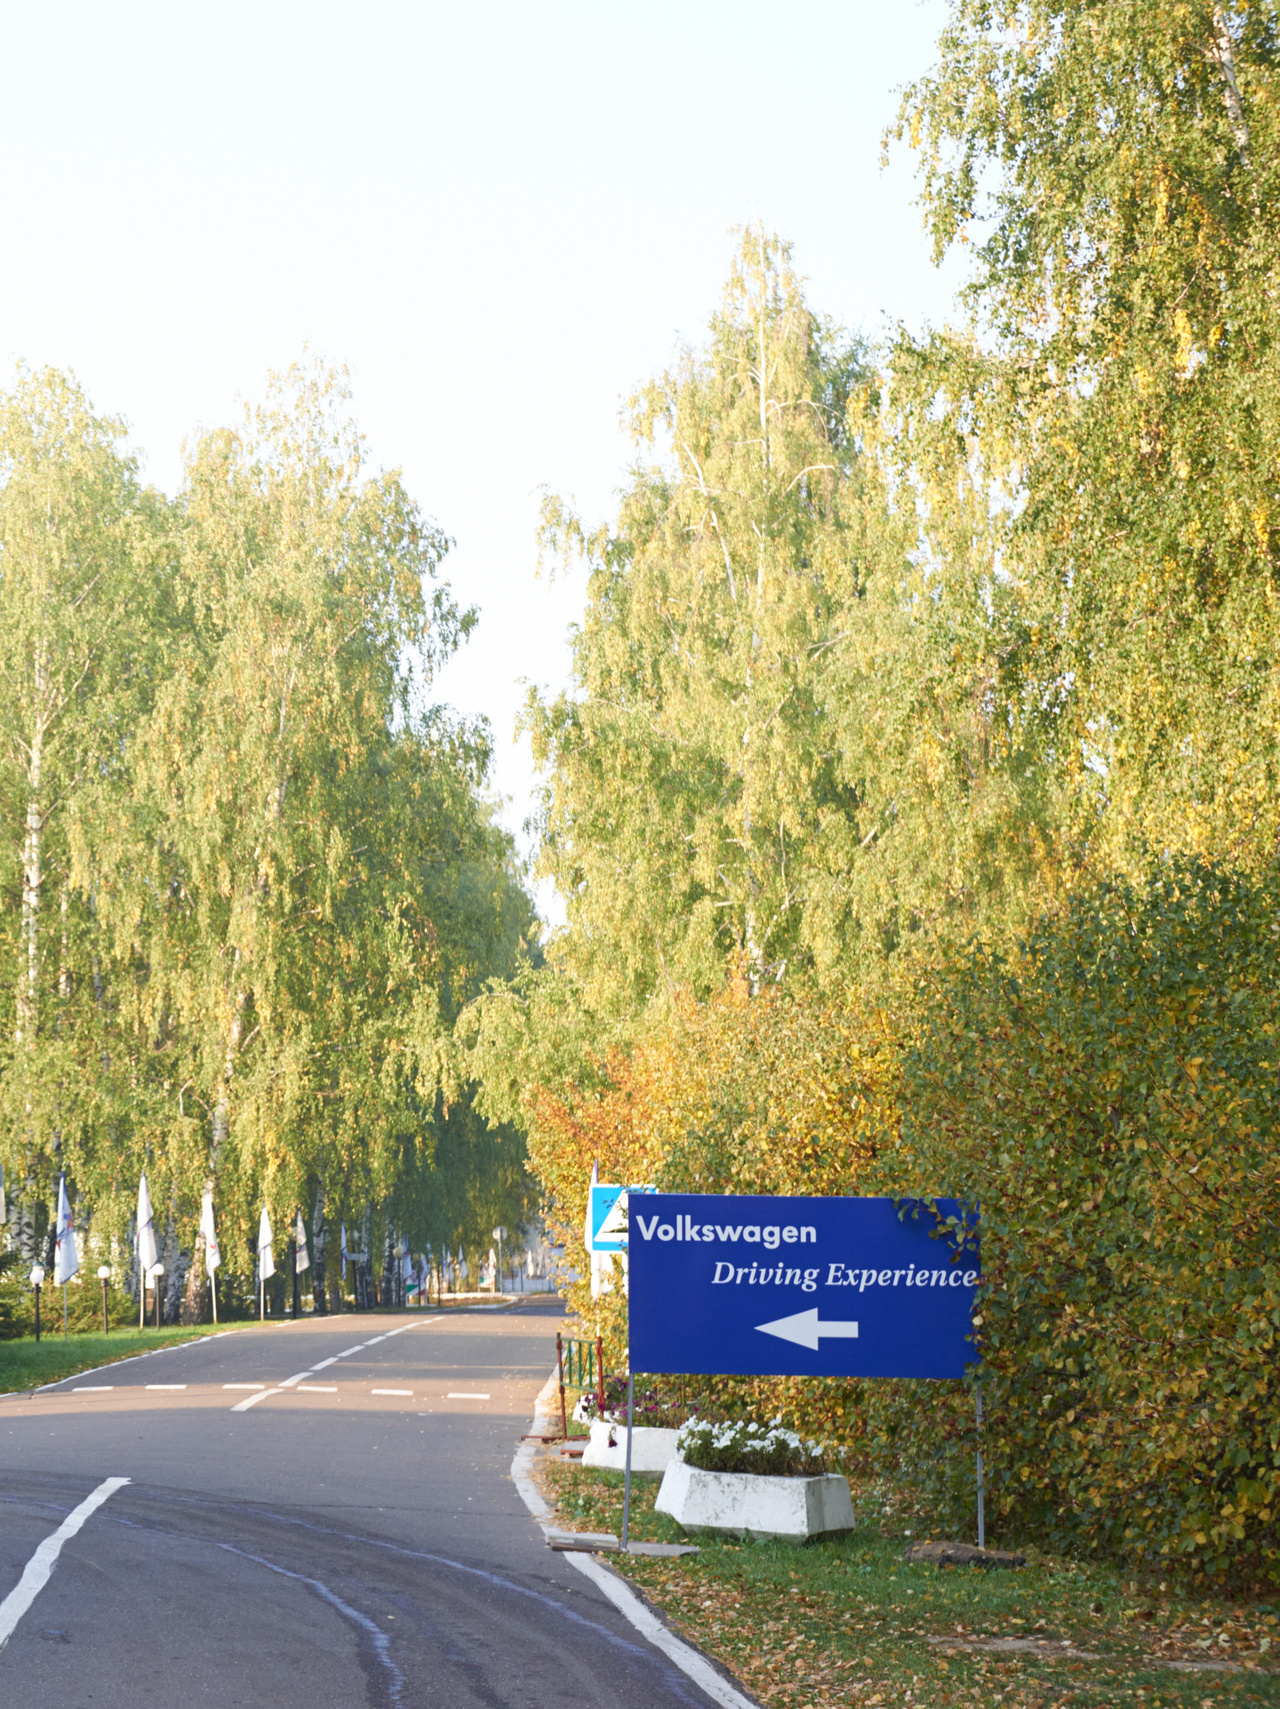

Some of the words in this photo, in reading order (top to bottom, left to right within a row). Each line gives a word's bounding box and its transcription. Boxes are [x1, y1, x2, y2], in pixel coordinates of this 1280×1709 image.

[635, 1214, 817, 1250] Volkswagen
[711, 1261, 820, 1292] Driving
[824, 1263, 978, 1293] Experience
